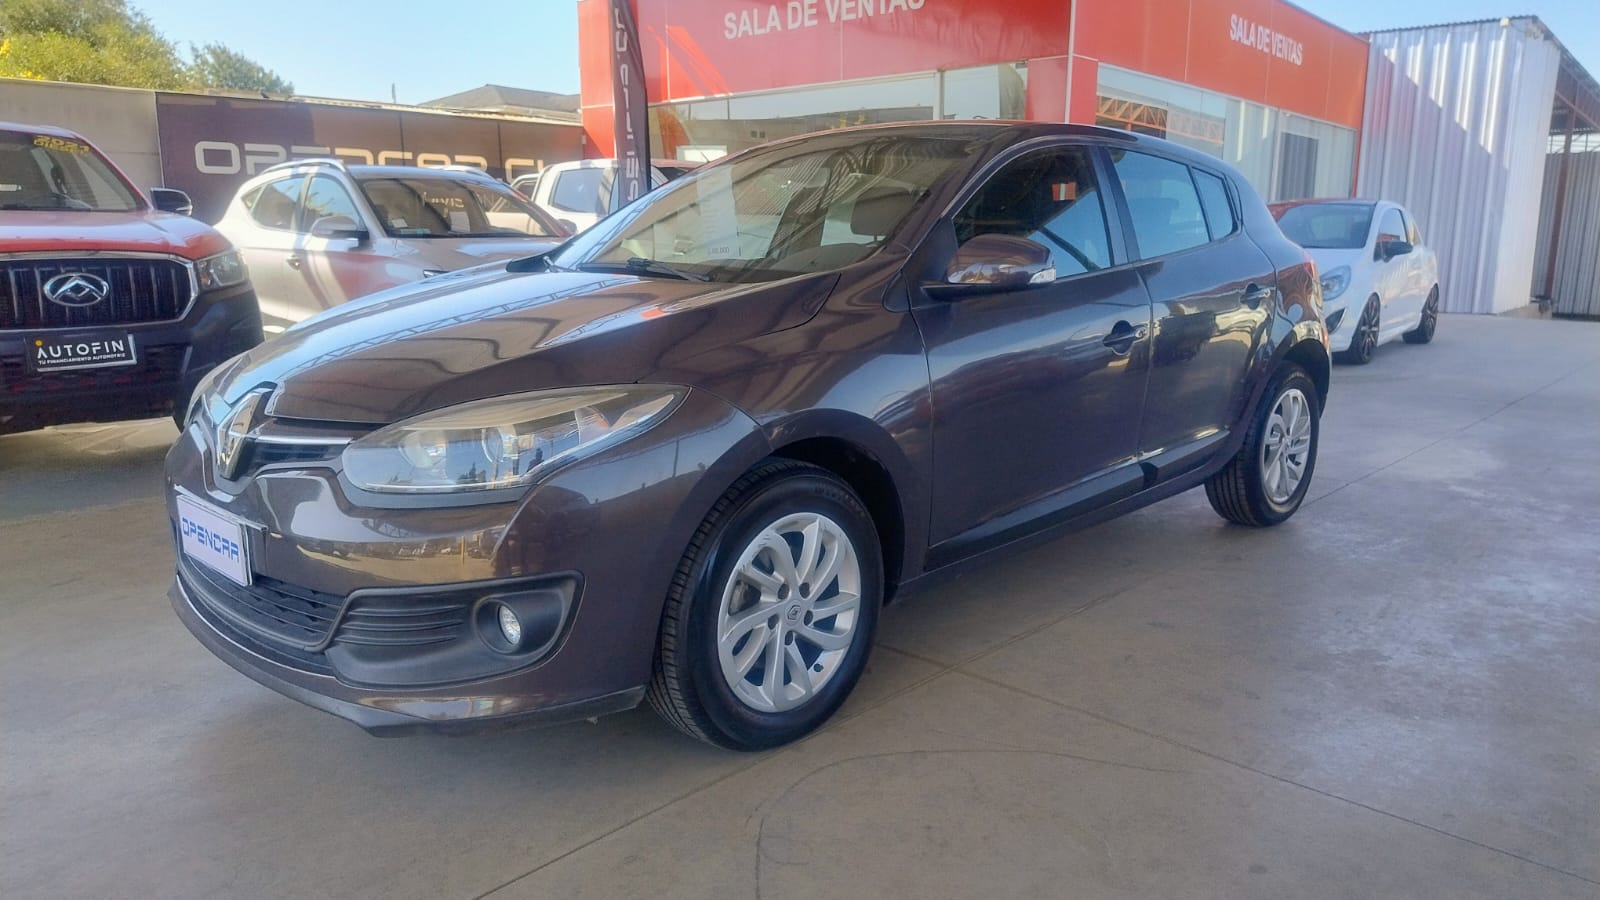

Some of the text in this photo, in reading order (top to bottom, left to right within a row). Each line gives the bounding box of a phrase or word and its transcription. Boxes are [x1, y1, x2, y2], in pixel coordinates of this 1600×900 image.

[724, 5, 781, 40] SALA
[787, 0, 818, 30] DE
[1230, 14, 1303, 66] SALA DE VENTAS
[37, 340, 124, 358] AUTOFIN
[182, 517, 239, 562] OPENCAR
